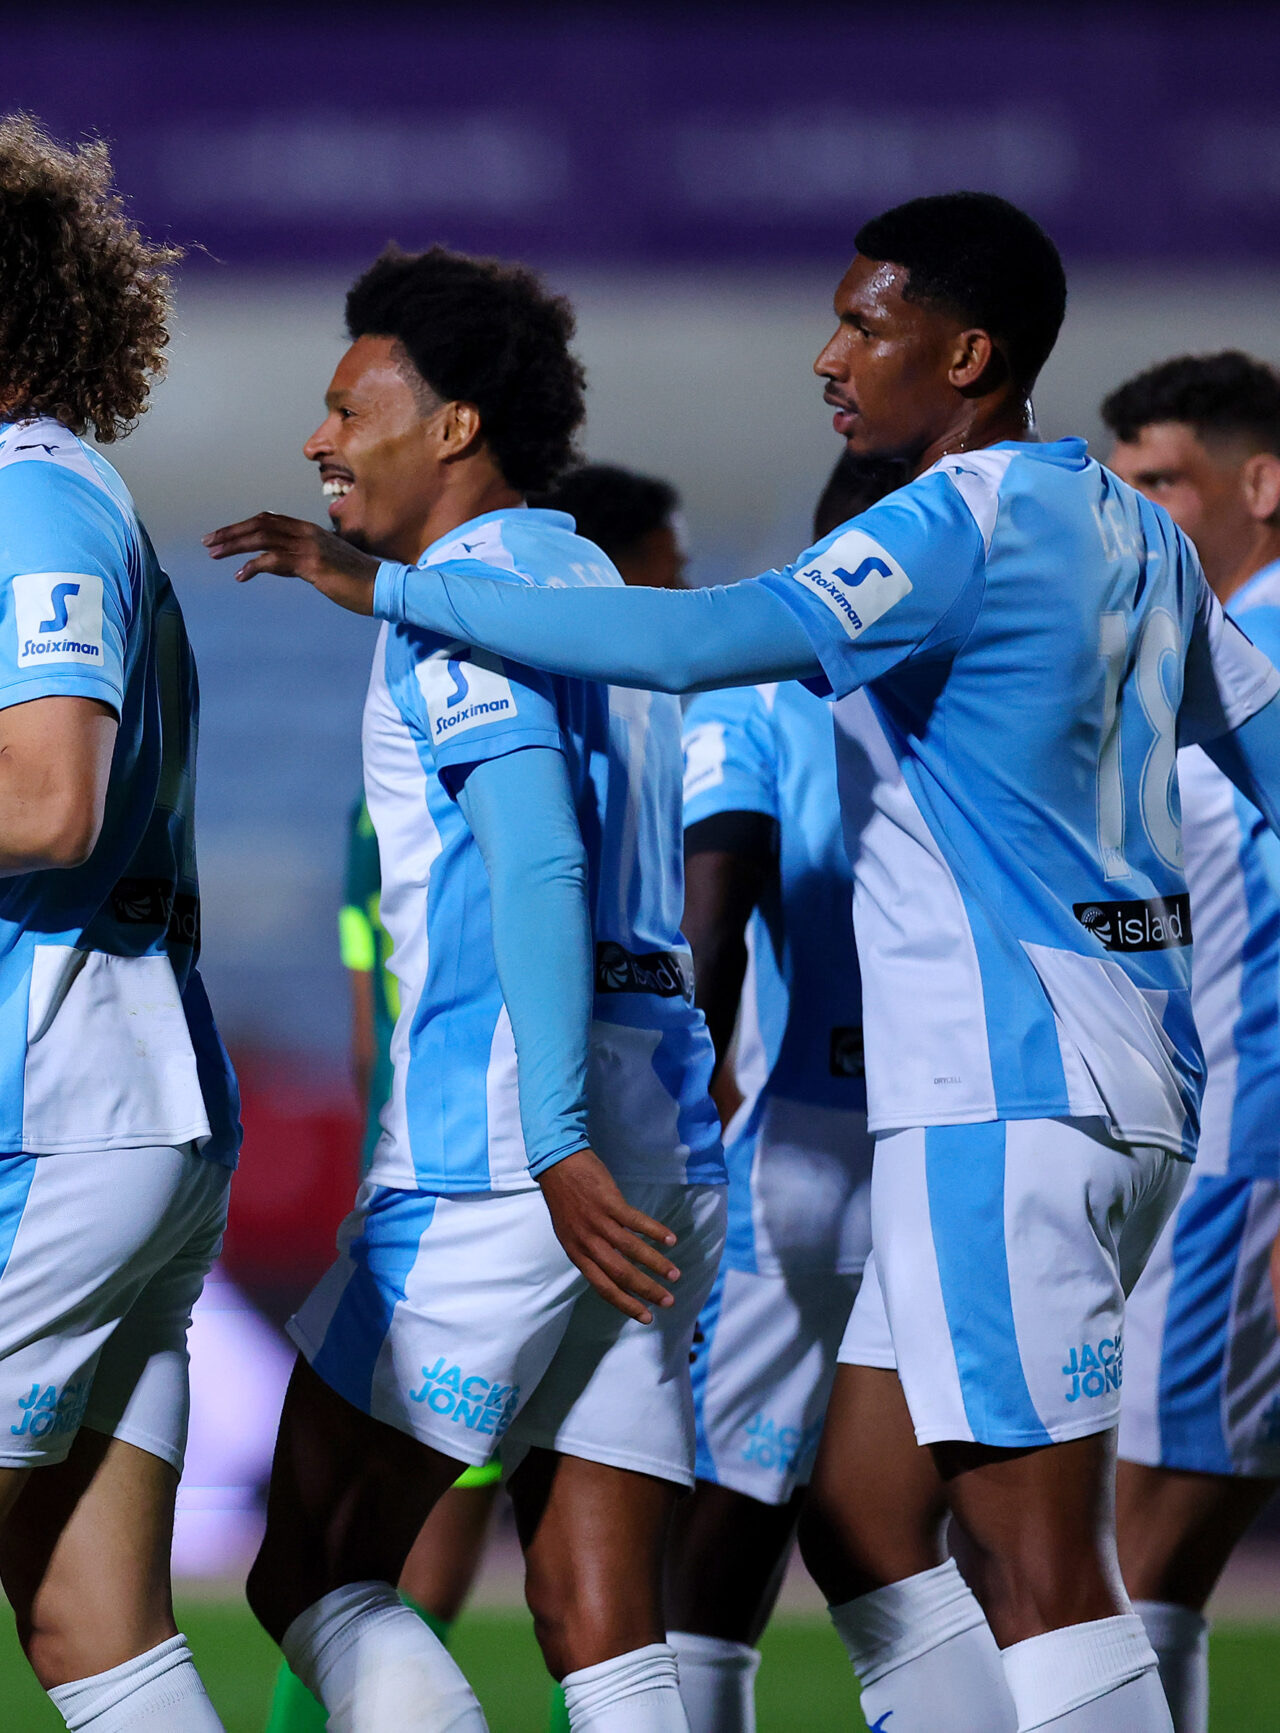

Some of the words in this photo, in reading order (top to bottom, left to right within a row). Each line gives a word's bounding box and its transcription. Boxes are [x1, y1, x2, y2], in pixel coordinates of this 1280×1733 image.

[803, 569, 863, 630] Stoiximan
[21, 639, 99, 658] Stoiximan
[435, 699, 510, 736] Stoiximan
